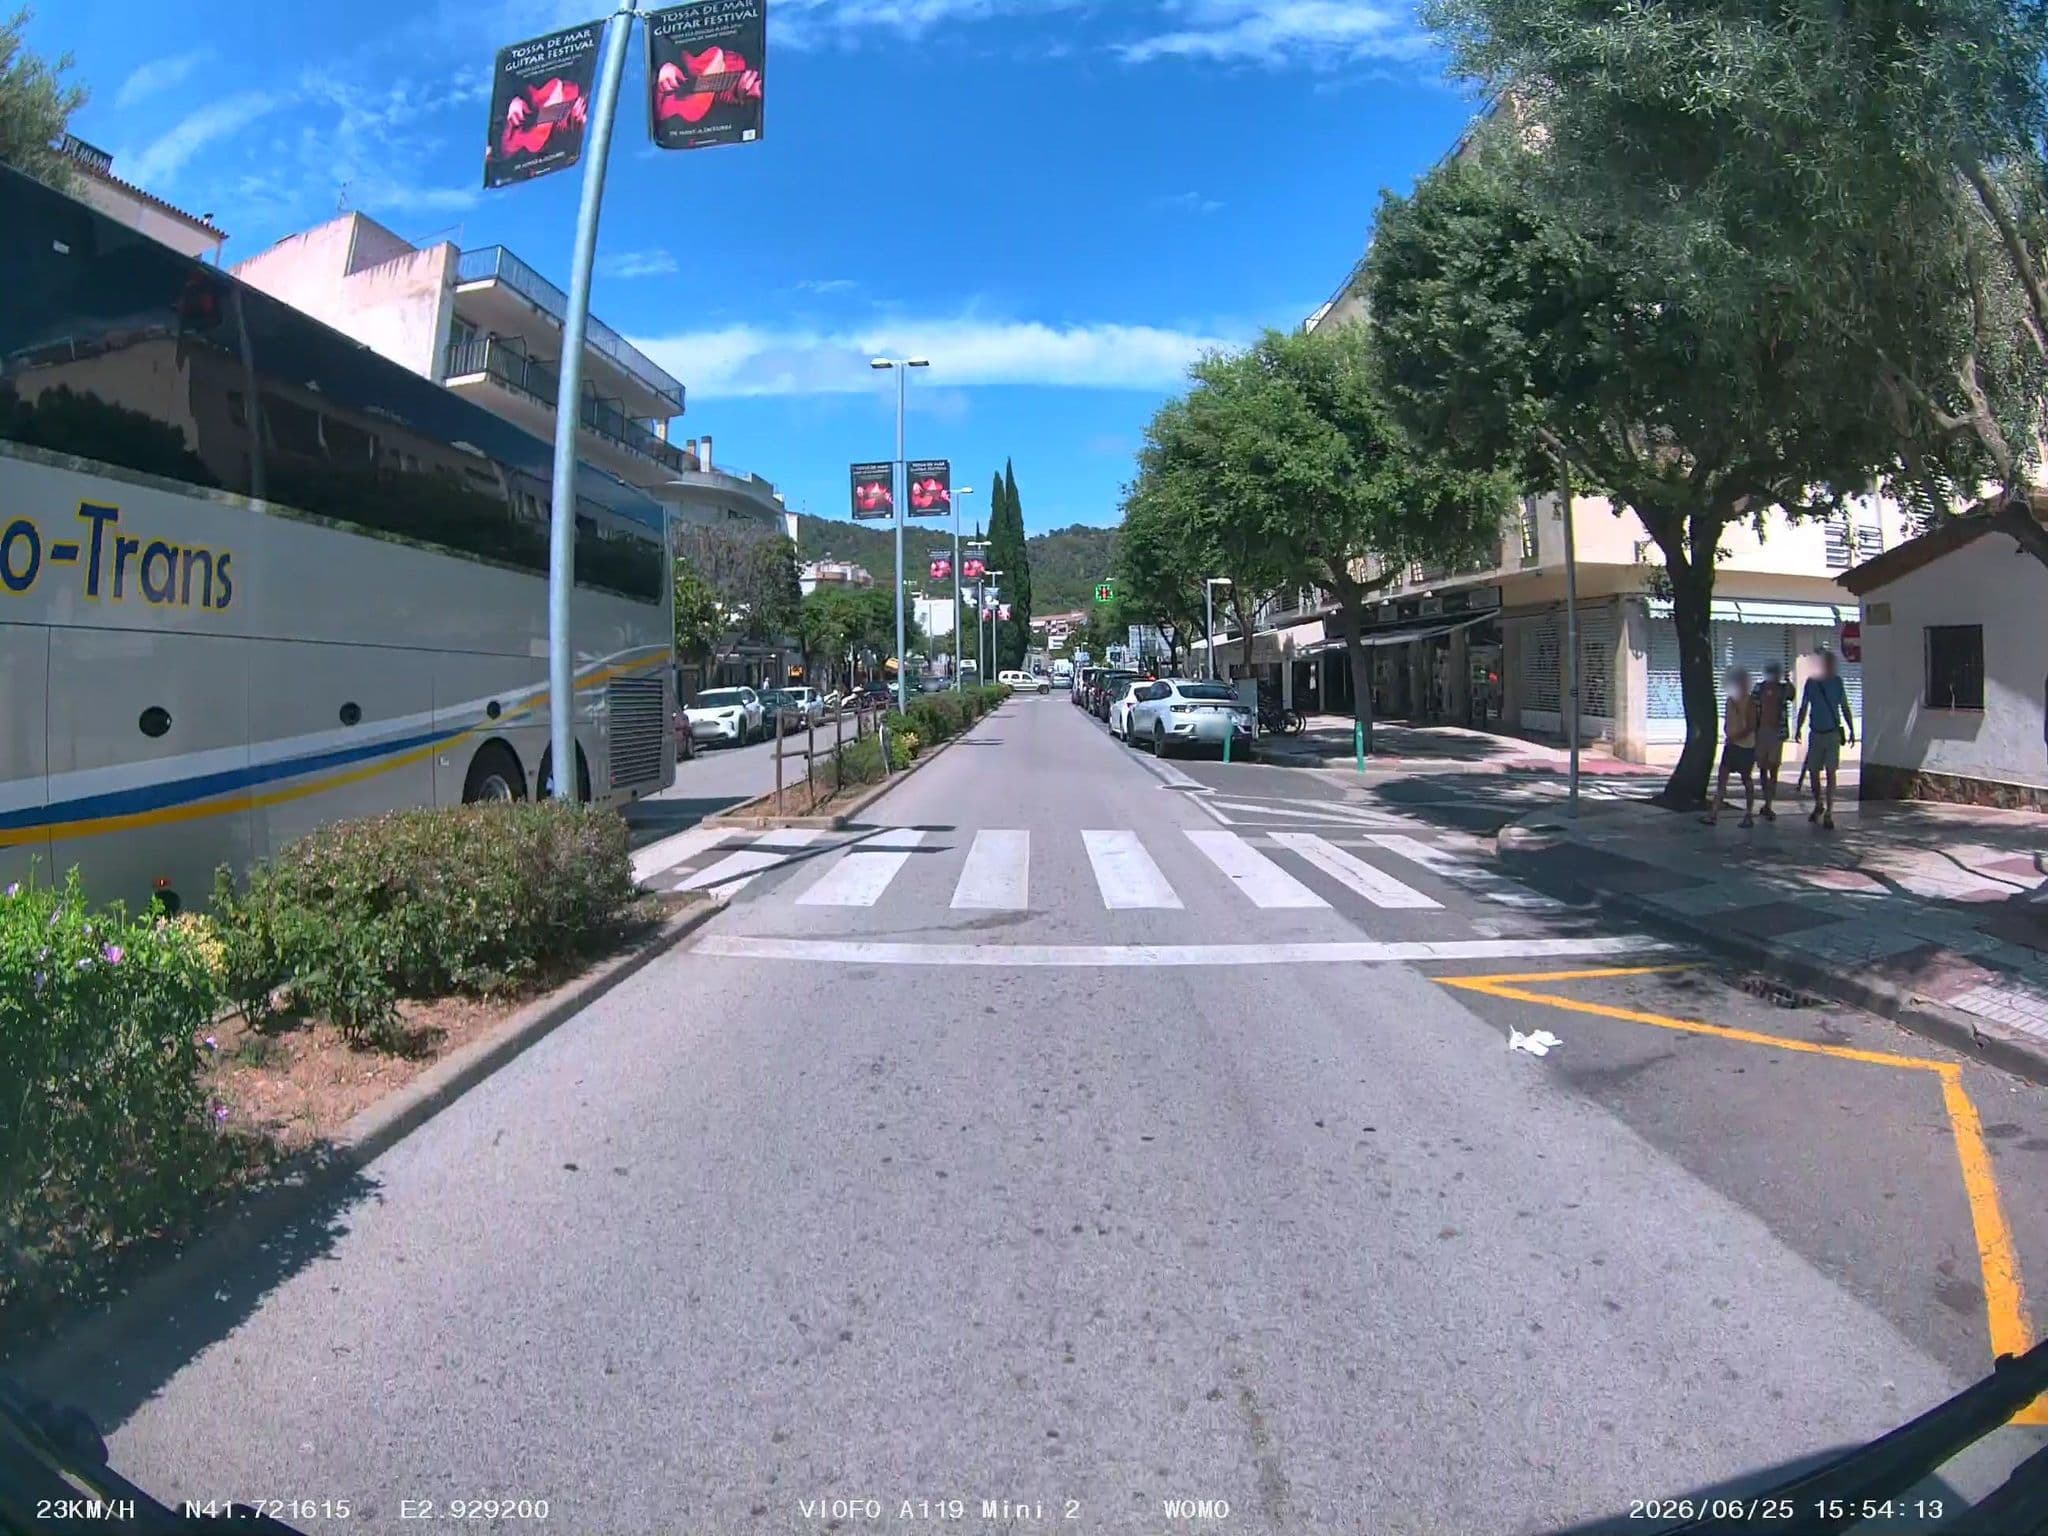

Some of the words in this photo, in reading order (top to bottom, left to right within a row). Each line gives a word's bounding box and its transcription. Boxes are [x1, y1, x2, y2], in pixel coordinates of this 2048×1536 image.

[654, 20, 700, 36] GUITAR
[704, 9, 759, 26] FESTIVAL
[660, 9, 699, 23] TOSSA
[703, 6, 718, 15] DE
[722, 0, 753, 11] MAR
[505, 53, 545, 72] GUITAR
[548, 39, 594, 59] FESTIVAL
[512, 43, 544, 59] TOSSA
[547, 37, 561, 48] DE
[563, 29, 591, 44] MAR
